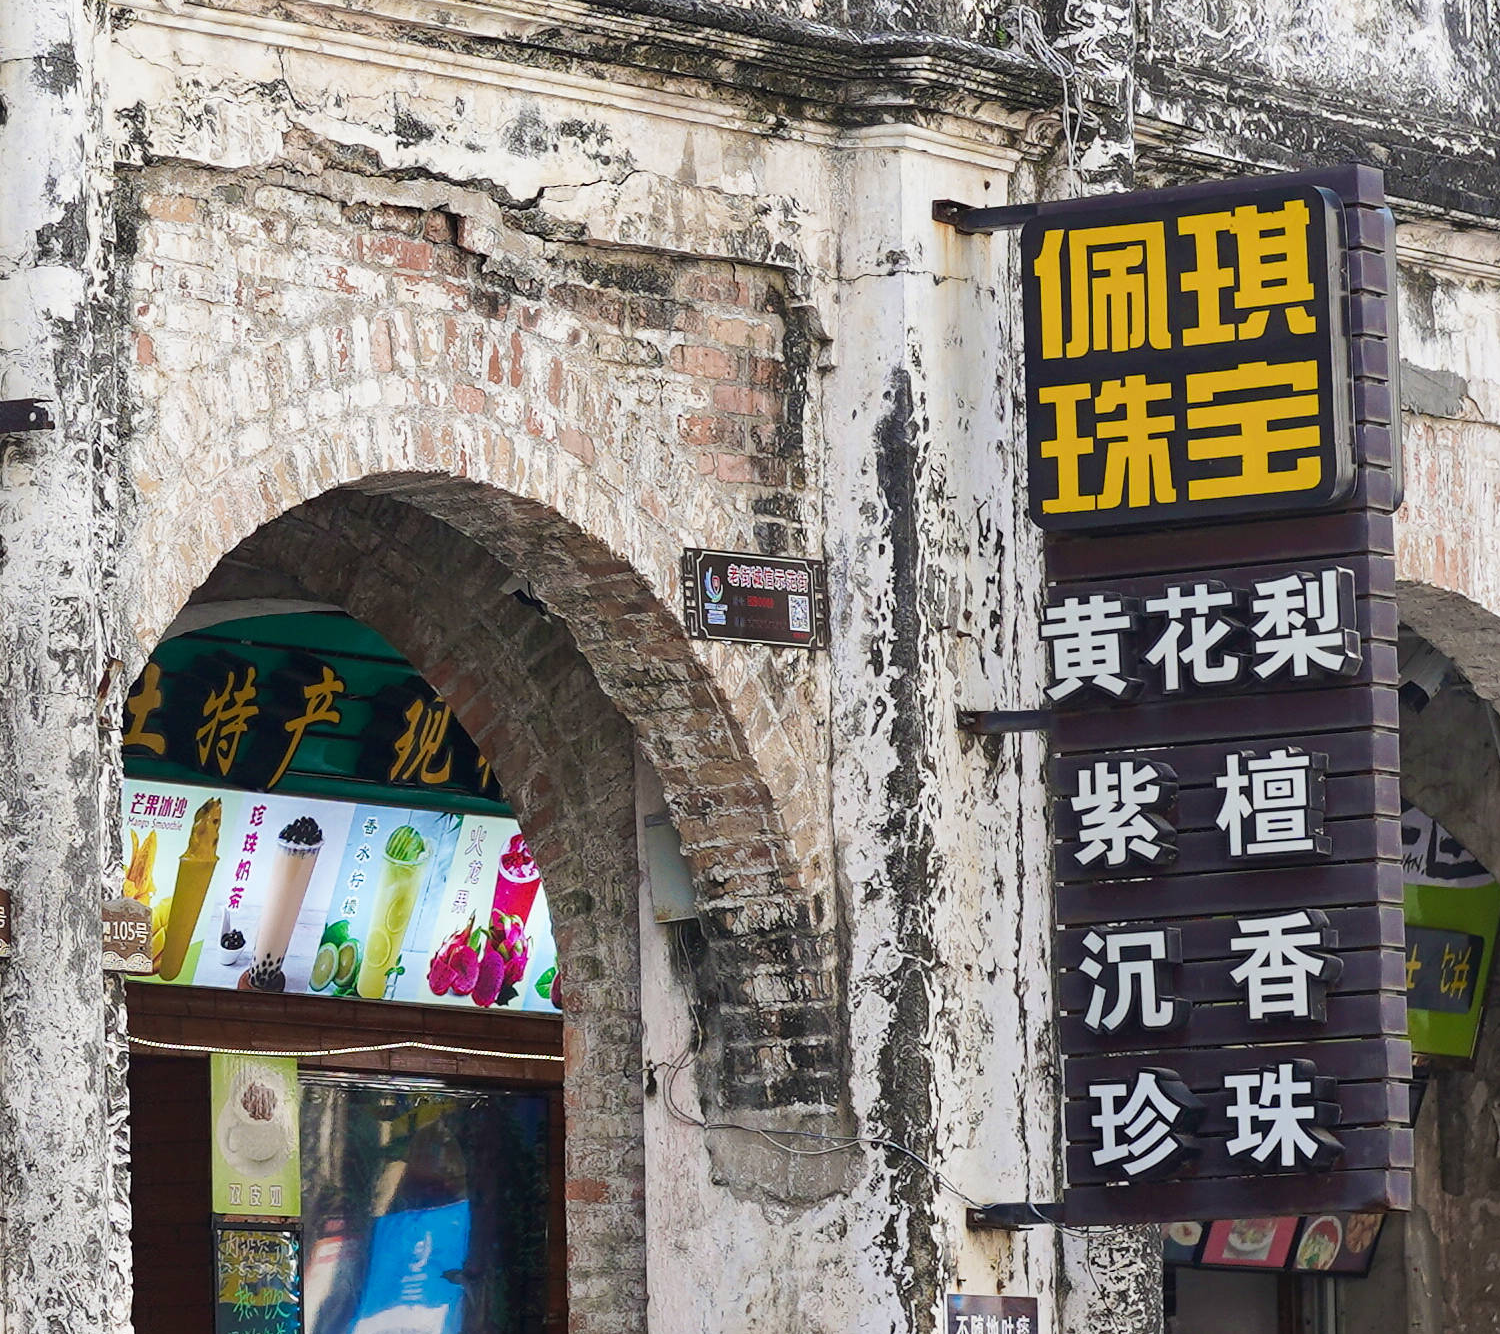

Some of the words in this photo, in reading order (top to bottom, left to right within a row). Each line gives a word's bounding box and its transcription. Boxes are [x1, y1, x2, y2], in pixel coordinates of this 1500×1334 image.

[1035, 200, 1318, 360] 佩琪
[1038, 361, 1321, 514] 珠宝
[1041, 569, 1347, 702] 黄花梨
[126, 816, 149, 829] Mango
[151, 818, 183, 831] Smoothie
[130, 793, 188, 819] 芒果冰沙
[228, 804, 267, 909] 珍珠奶茶
[1071, 749, 1315, 867] 紫檀
[342, 817, 379, 916] 香水柠檬
[450, 824, 488, 914] 火龙果
[113, 920, 149, 944] 105号
[1078, 911, 1325, 1031] 沉香
[1090, 1063, 1319, 1176] 珍珠
